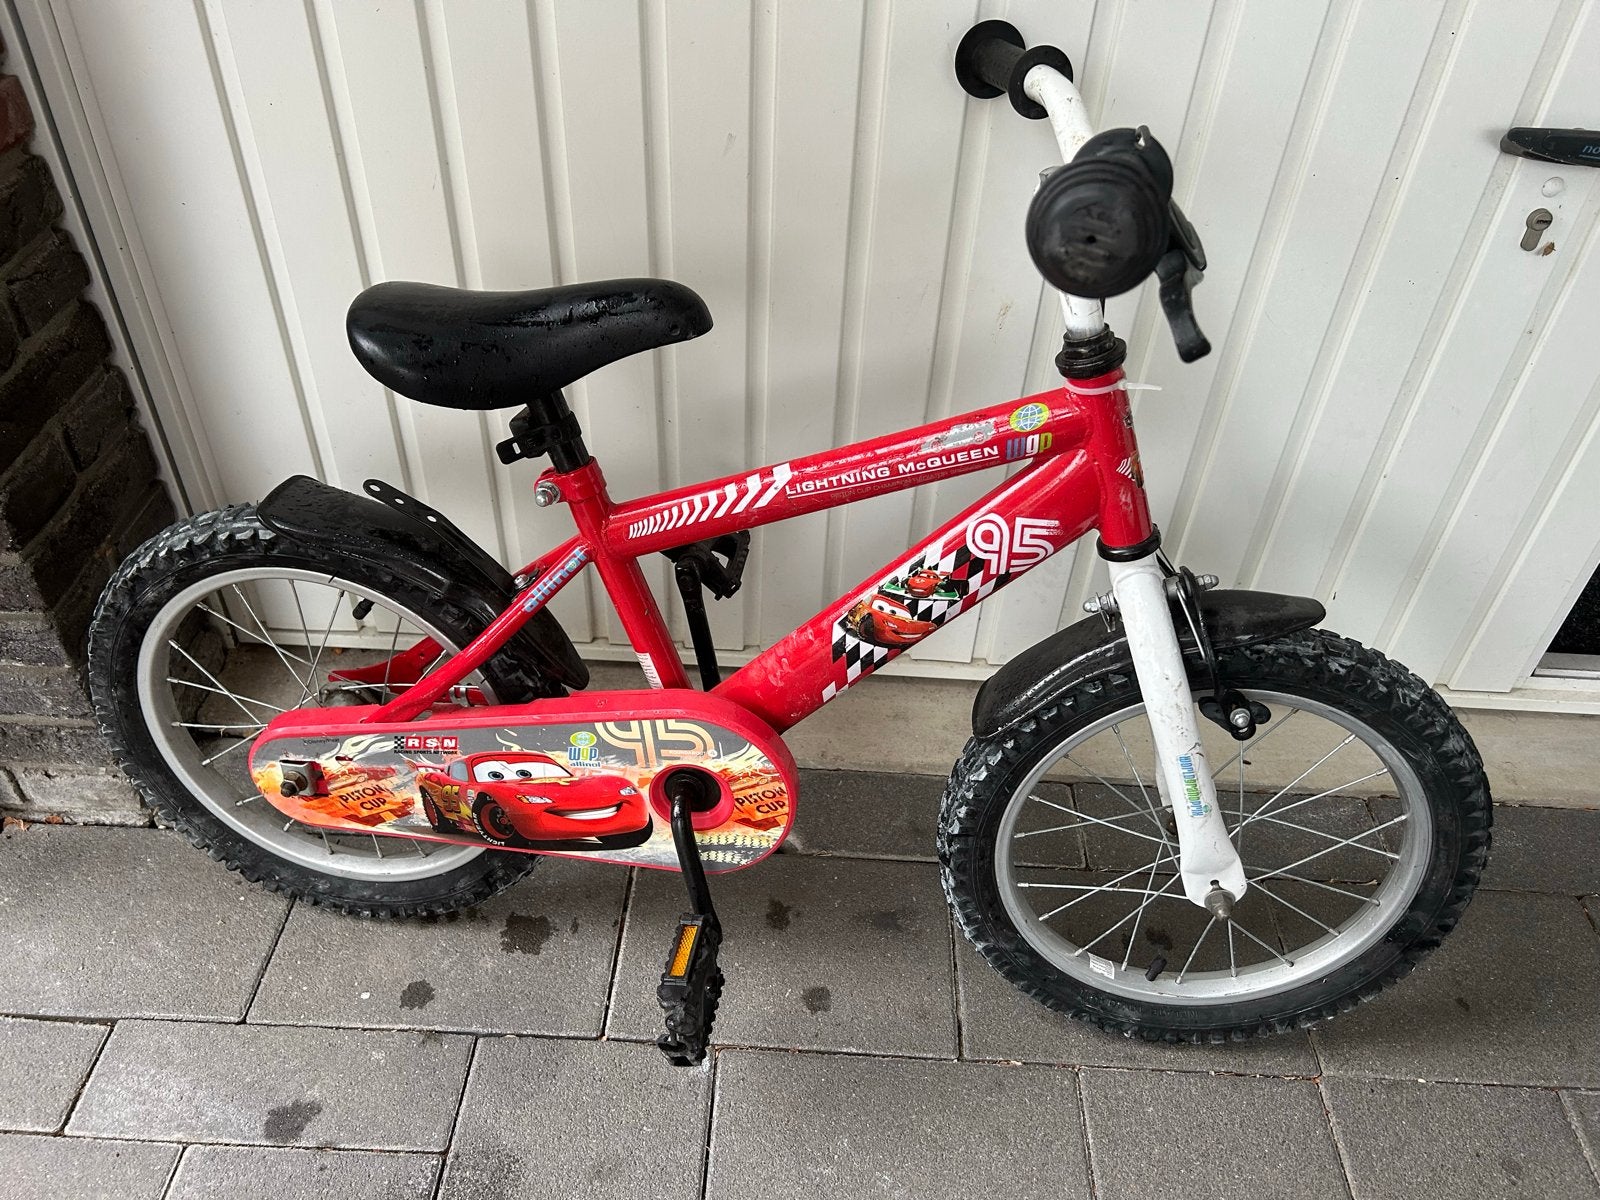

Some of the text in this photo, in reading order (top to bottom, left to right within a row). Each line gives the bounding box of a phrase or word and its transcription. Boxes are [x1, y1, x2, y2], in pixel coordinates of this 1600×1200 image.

[786, 466, 891, 495] LIGHTNING
[899, 445, 999, 475] McQUEEN
[966, 513, 1062, 574] 95
[407, 738, 457, 749] RSN
[338, 784, 387, 803] PISTON
[442, 784, 462, 814] 95
[734, 786, 787, 806] PISTON
[360, 797, 387, 811] CUP
[756, 800, 786, 814] CUP
